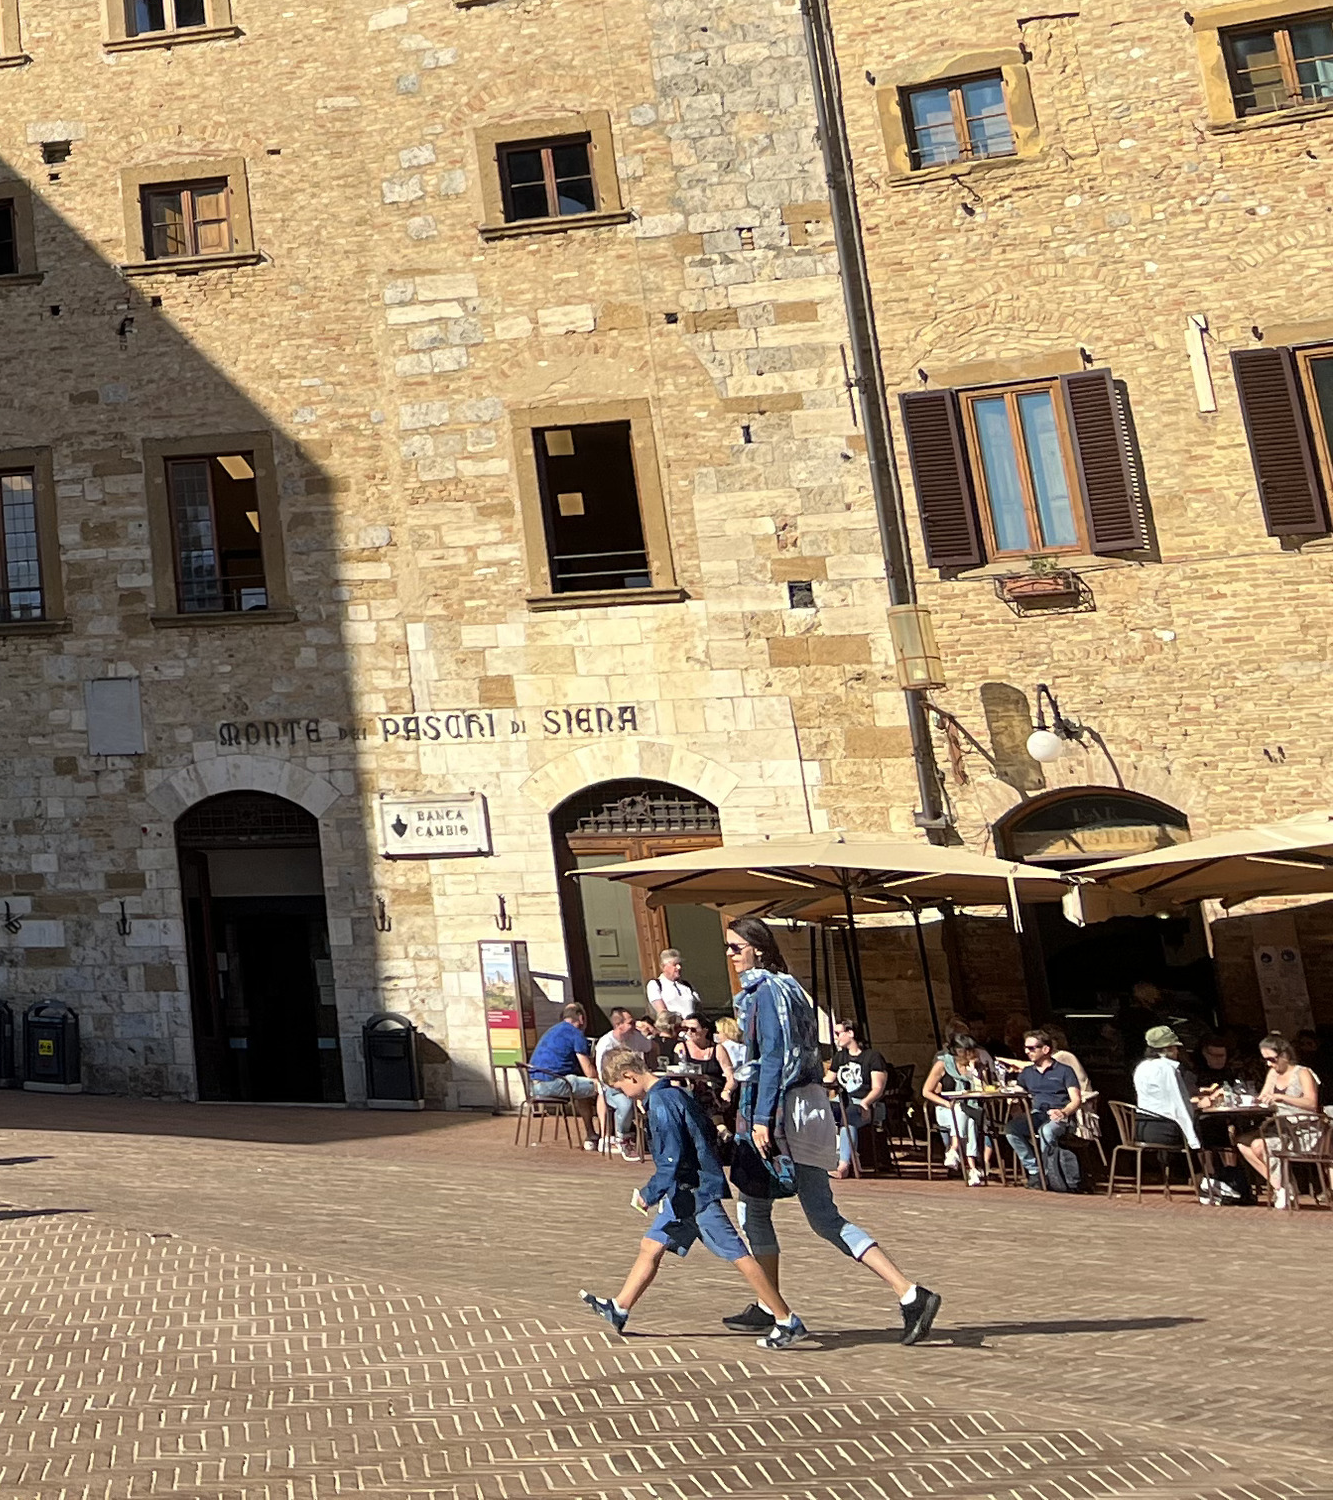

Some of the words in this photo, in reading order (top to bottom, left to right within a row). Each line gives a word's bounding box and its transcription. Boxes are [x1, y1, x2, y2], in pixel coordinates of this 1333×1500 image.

[219, 719, 322, 746] MONTE
[381, 714, 495, 743] PASCHI
[510, 719, 526, 734] DI
[543, 706, 638, 734] SIENA
[416, 809, 465, 821] BANCA
[1072, 806, 1119, 821] BAR
[415, 824, 469, 838] CAMBIO
